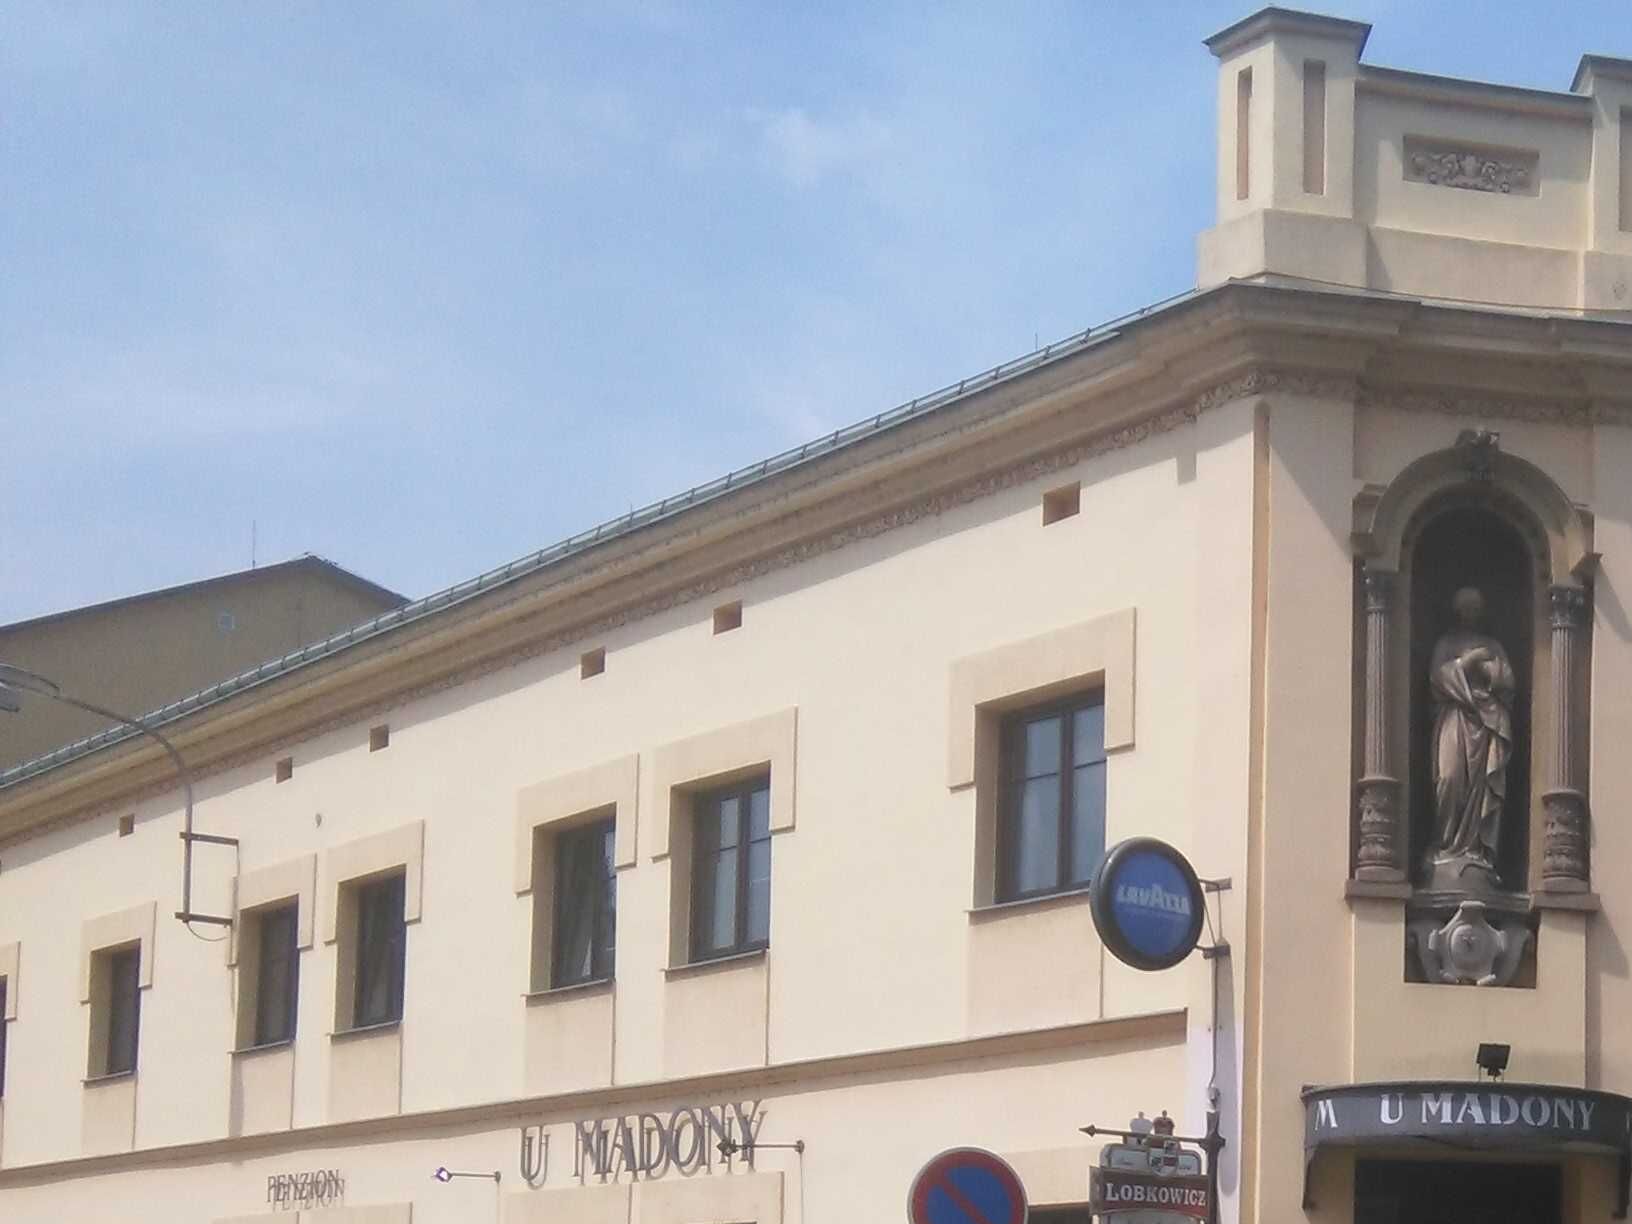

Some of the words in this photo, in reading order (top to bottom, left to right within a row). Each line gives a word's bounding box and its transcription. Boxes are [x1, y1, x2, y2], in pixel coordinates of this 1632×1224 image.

[1314, 1099, 1338, 1131] M
[1379, 1094, 1404, 1125] U
[1420, 1092, 1596, 1131] MADONY
[520, 1125, 545, 1182] U
[574, 1100, 762, 1177] MADONY
[267, 1169, 341, 1202] PENZION
[1104, 1182, 1206, 1206] LOBKOWICZ
